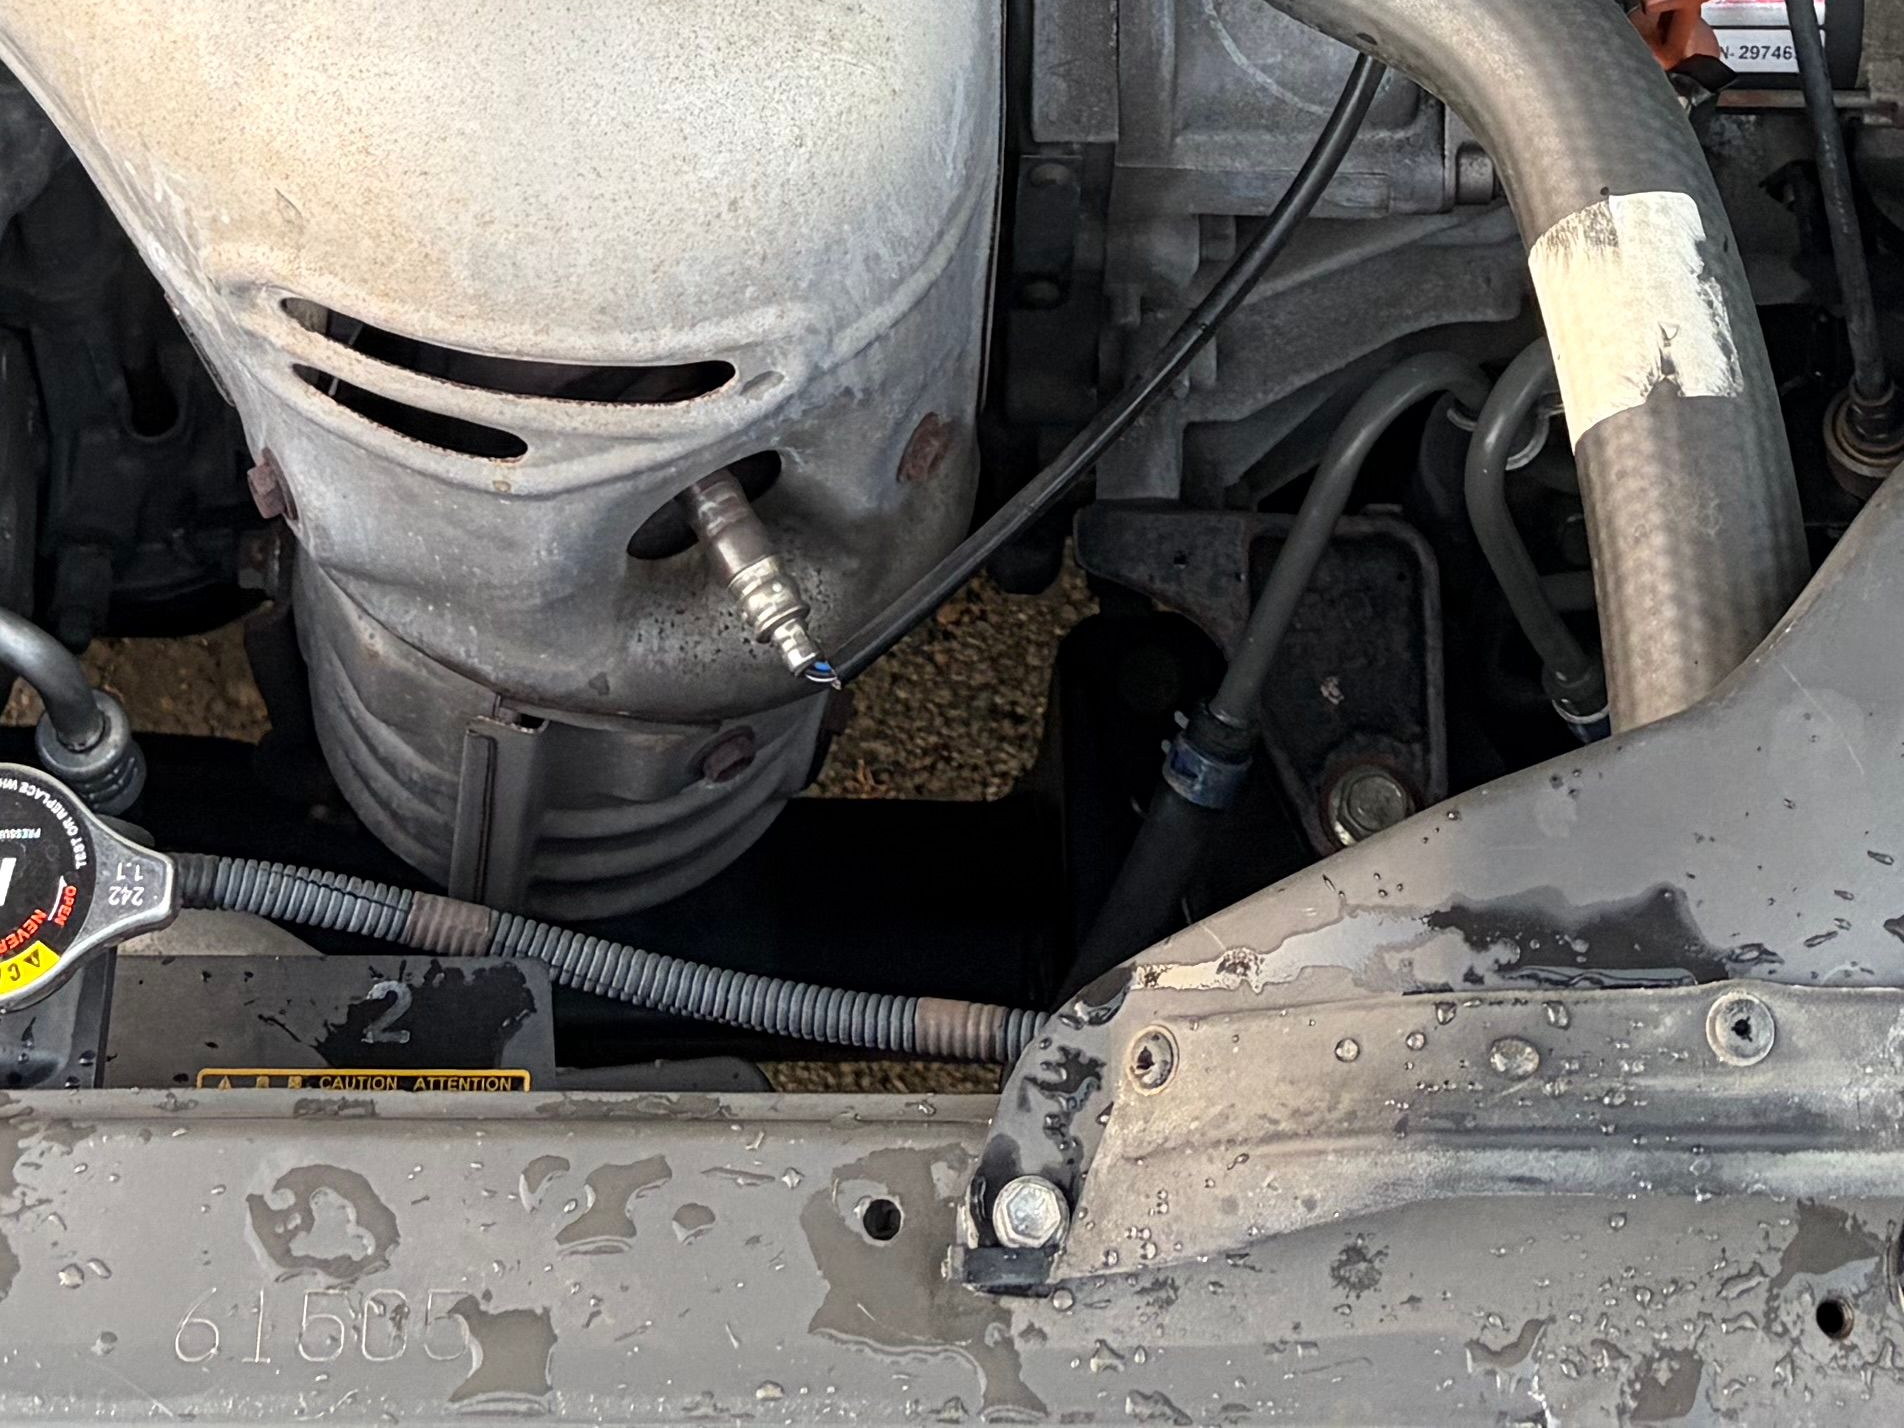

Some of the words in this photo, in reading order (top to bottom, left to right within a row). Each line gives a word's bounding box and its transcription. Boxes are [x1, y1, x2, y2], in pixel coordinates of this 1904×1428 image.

[20, 779, 68, 820] REPLACE
[60, 816, 78, 837] OR
[69, 836, 87, 869] TEST
[115, 860, 144, 880] 1.1
[53, 884, 77, 928] OPEN
[107, 885, 144, 905] 242
[360, 979, 413, 1044] 2
[319, 1075, 398, 1092] CAUTION
[413, 1075, 513, 1092] ATTENTION
